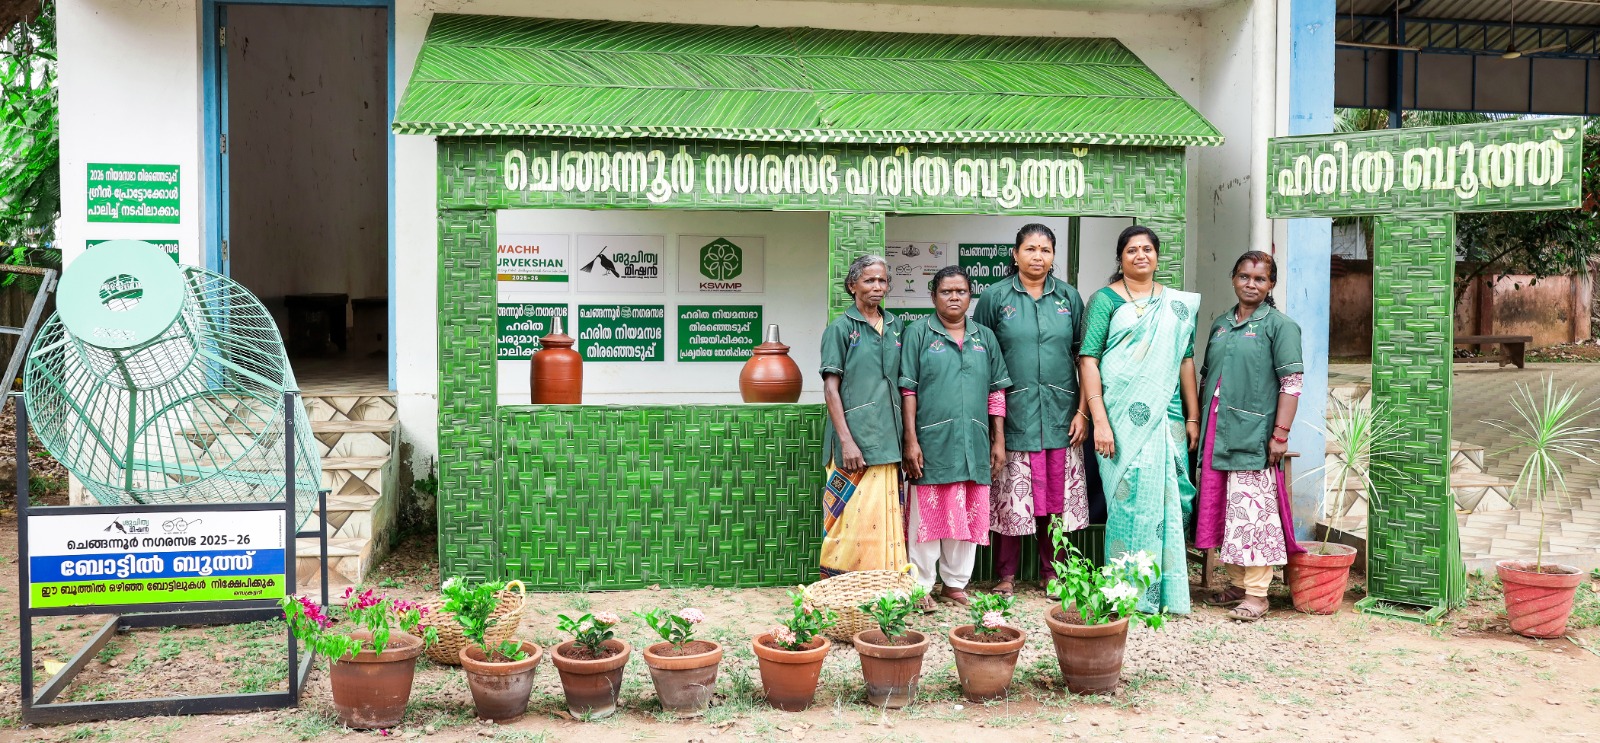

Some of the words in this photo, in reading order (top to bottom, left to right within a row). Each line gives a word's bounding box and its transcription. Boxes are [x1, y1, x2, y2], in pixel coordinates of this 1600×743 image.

[1278, 141, 1395, 197] ഹരിത
[1402, 127, 1576, 199] ബൂത്ത്
[90, 169, 104, 181] 2026
[504, 145, 695, 203] ചെങ്ങന്നൂർ
[705, 153, 839, 195] നഗരസഭ
[89, 185, 112, 200] ഗ്രീൻ
[88, 202, 120, 219] പാലിച്ച്
[121, 203, 179, 217] നടപ്പിലാക്കാം
[497, 245, 540, 254] WACHH
[960, 244, 998, 260] ചെങ്ങന്നൂർ
[497, 258, 563, 268] URVEKSHAN
[613, 250, 658, 266] ശുചിത്വ
[625, 264, 658, 276] മിഷൻ
[580, 305, 620, 321] ചെങ്ങന്നൂർ
[632, 308, 664, 318] നഗരസഭ
[681, 309, 710, 319] ഹരിത
[712, 309, 758, 319] നിയമസഭാ
[505, 319, 544, 331] ഹരിത
[580, 323, 612, 340] ഹരിത
[615, 323, 662, 340] നിയമസഭ
[689, 334, 753, 344] വിജയിപ്പിക്കാം
[586, 342, 657, 362] തിരഞ്ഞെടുപ്പ്
[67, 537, 139, 550] ചെങ്ങന്നൂർ
[142, 536, 197, 548] നഗരസഭ
[60, 554, 164, 578] ബോട്ടിൽ
[173, 550, 257, 576] ബൂത്ത്
[42, 586, 58, 598] ഈ
[60, 583, 106, 596] ബൂത്തിൽ
[109, 582, 144, 592] ഒഴിഞ്ഞ
[146, 579, 206, 592] ബോട്ടിലുകൾ
[211, 578, 275, 590] നിക്ഷേപിക്കുക
